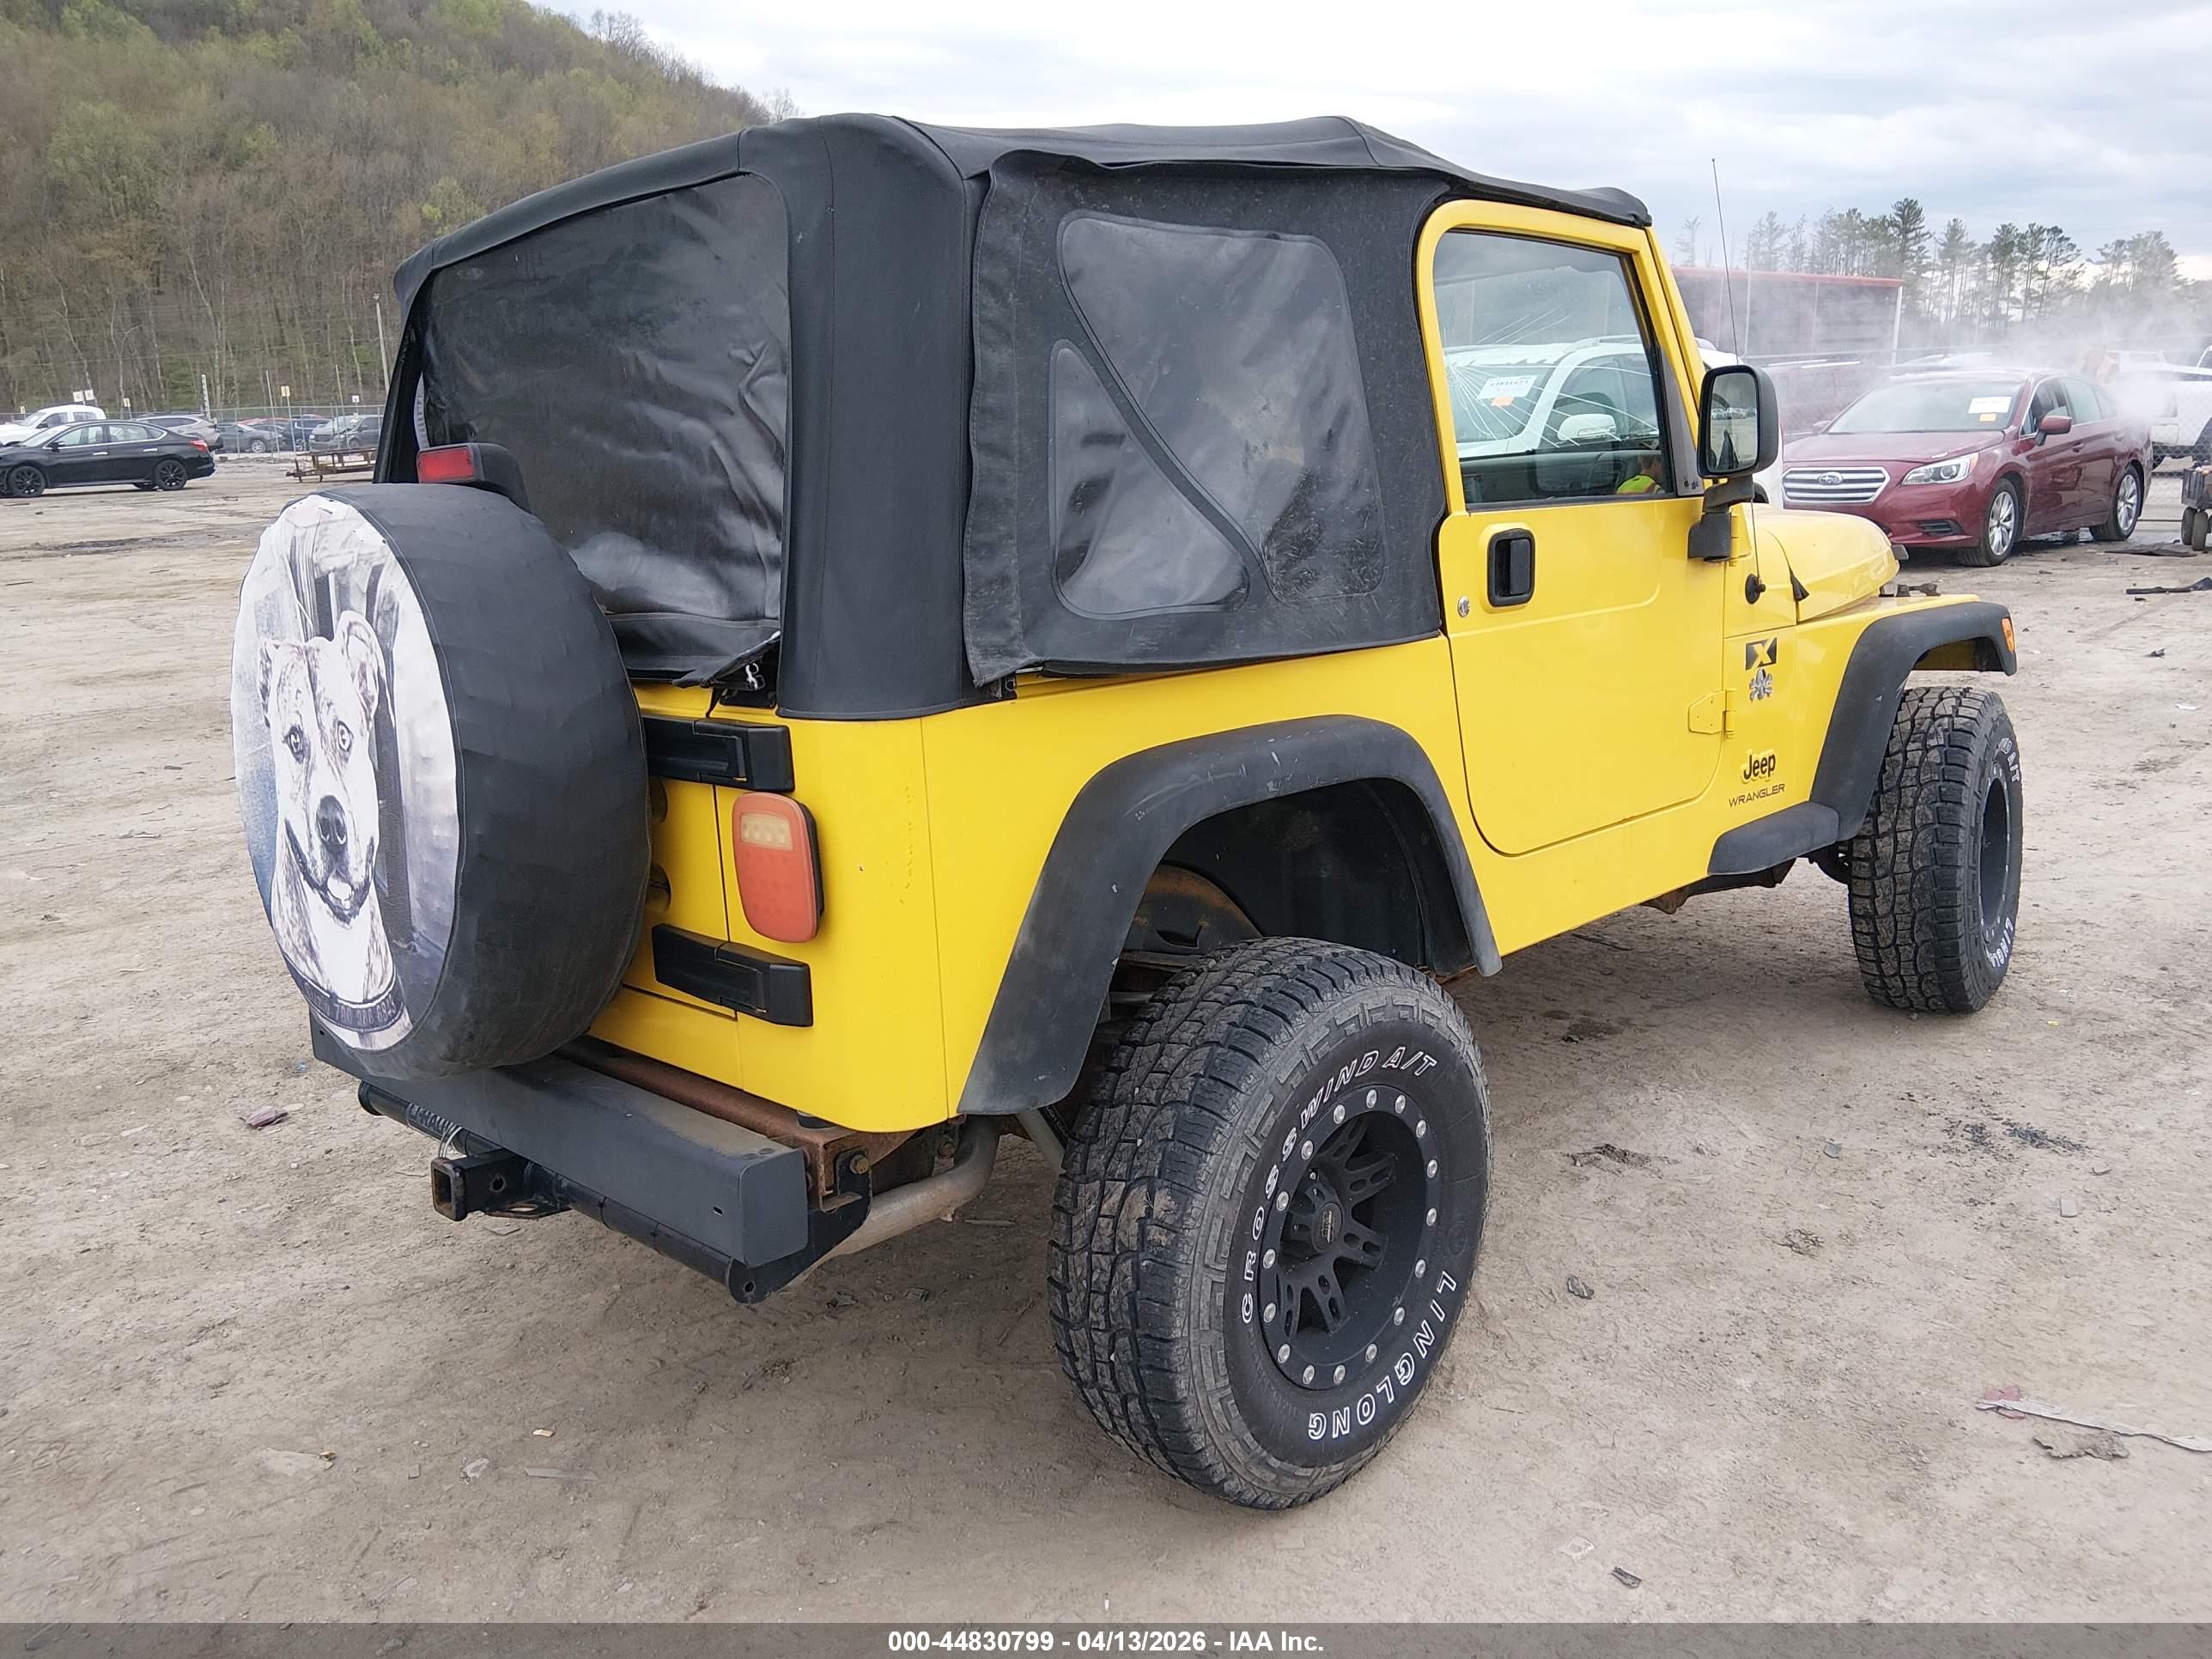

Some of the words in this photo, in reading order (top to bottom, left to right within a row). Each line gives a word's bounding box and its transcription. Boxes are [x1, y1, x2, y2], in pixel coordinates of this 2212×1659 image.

[1746, 637, 1778, 671] X
[1743, 752, 1777, 781] Jeep
[1729, 783, 1785, 808] WRANGLER
[1382, 1046, 1437, 1076] A/T
[1308, 1270, 1457, 1440] LINGLONG
